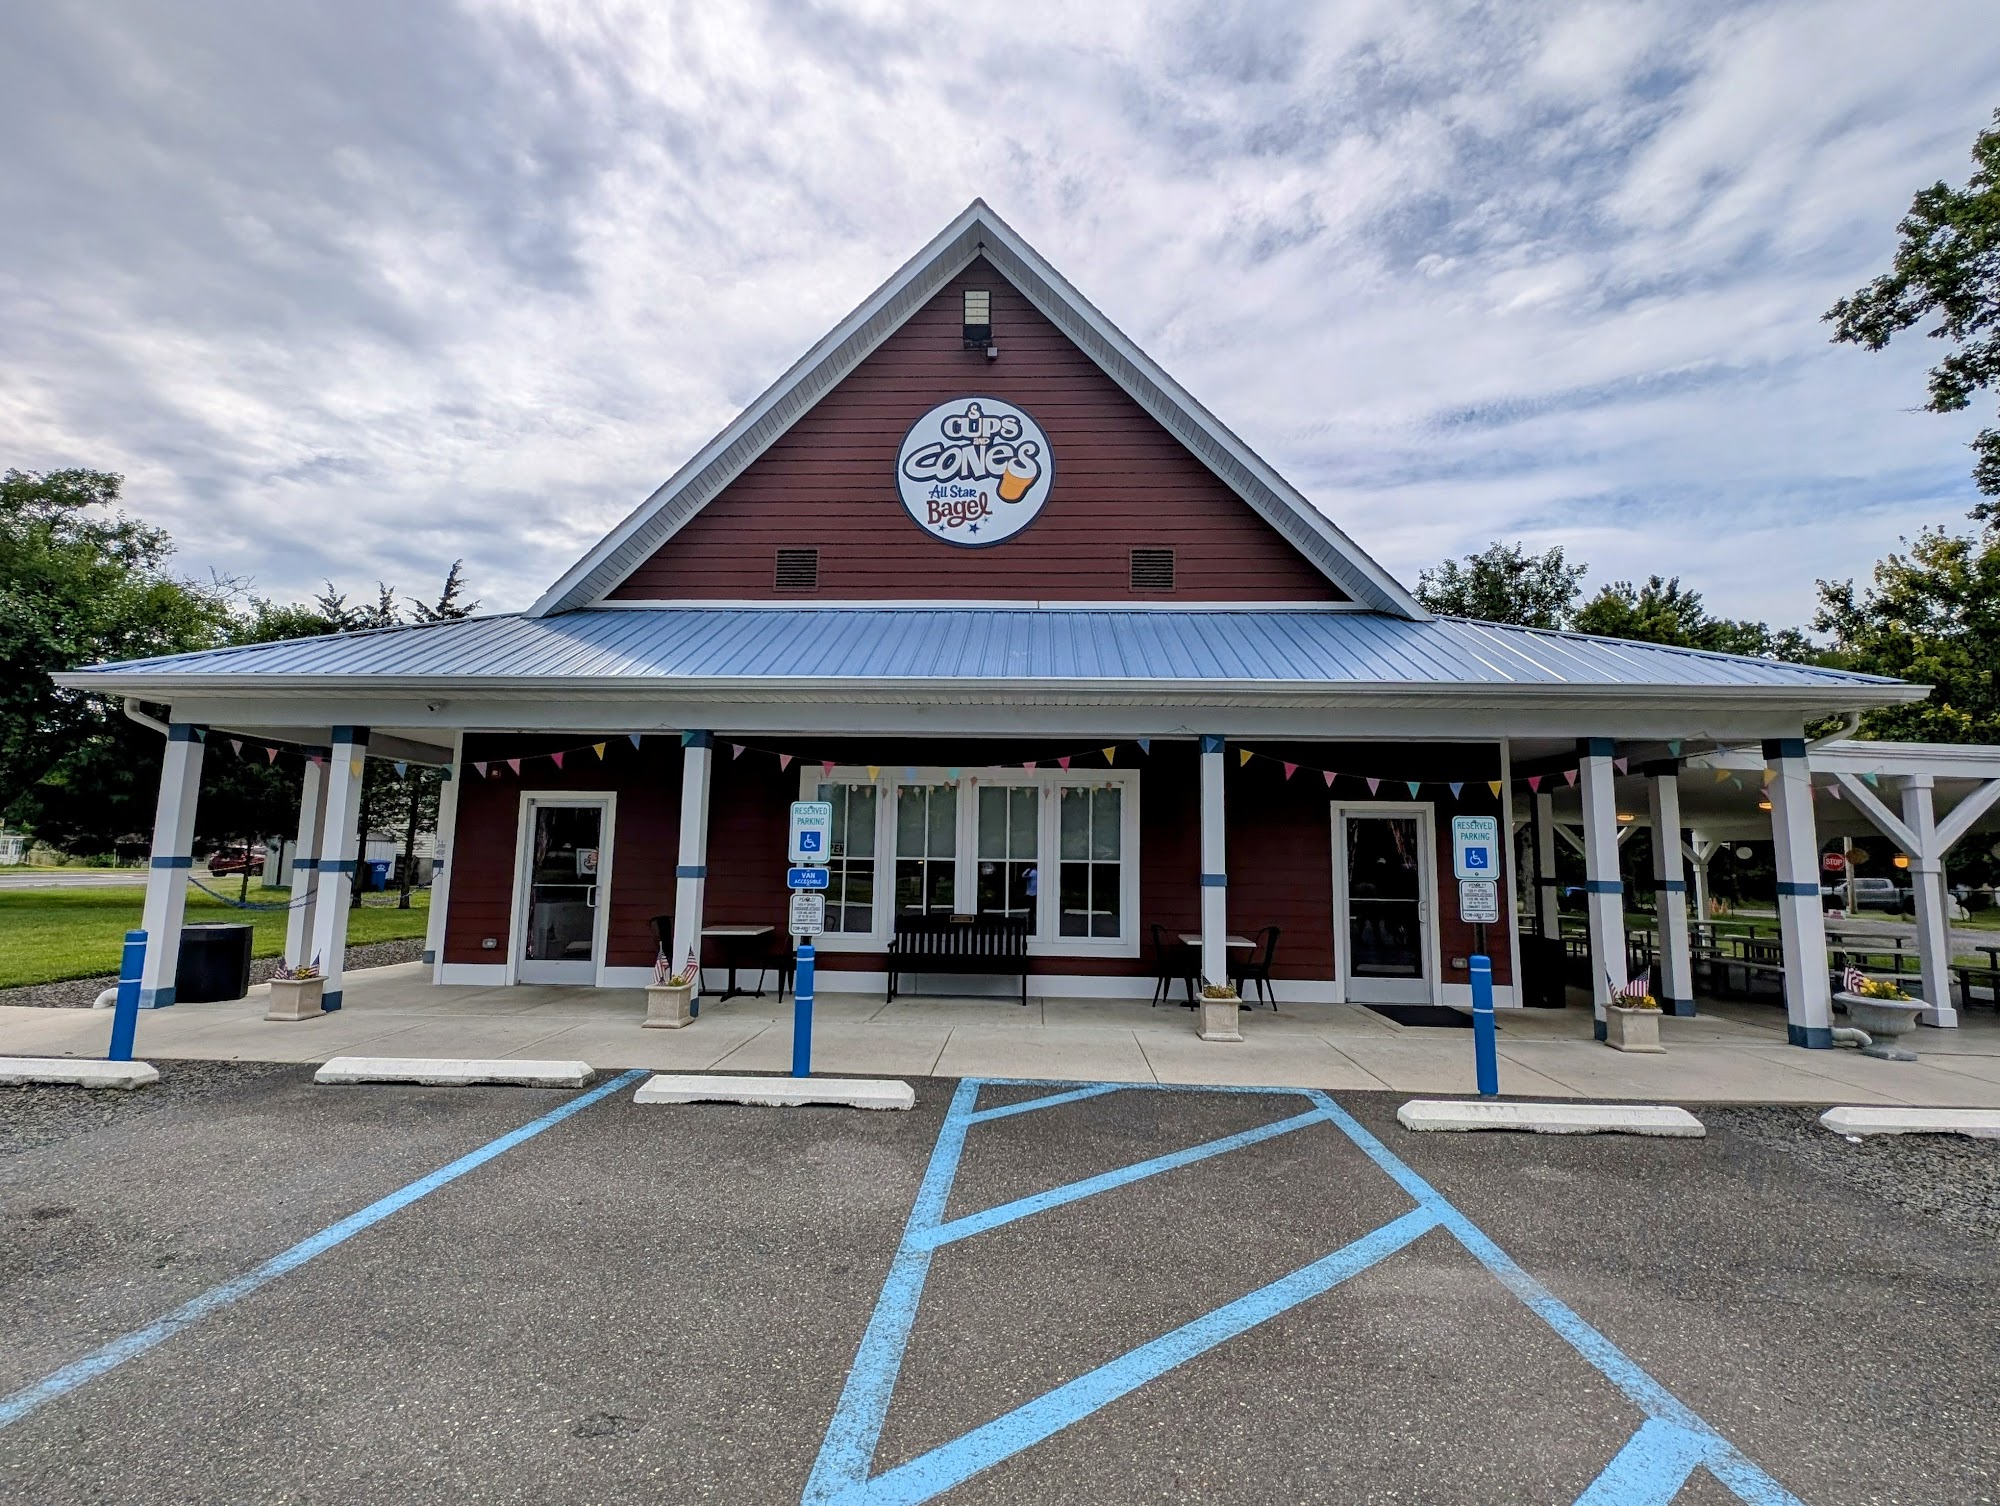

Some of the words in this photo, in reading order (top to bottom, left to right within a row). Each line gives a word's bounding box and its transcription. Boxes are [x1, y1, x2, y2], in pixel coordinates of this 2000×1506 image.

[942, 413, 1022, 441] CUPS
[929, 484, 949, 499] All
[927, 492, 993, 528] Bagel
[795, 806, 828, 815] RESERVED
[797, 817, 825, 826] PARKING
[1457, 821, 1493, 830] RESERVED
[1460, 832, 1490, 841] PARKING
[1825, 858, 1843, 866] STOP
